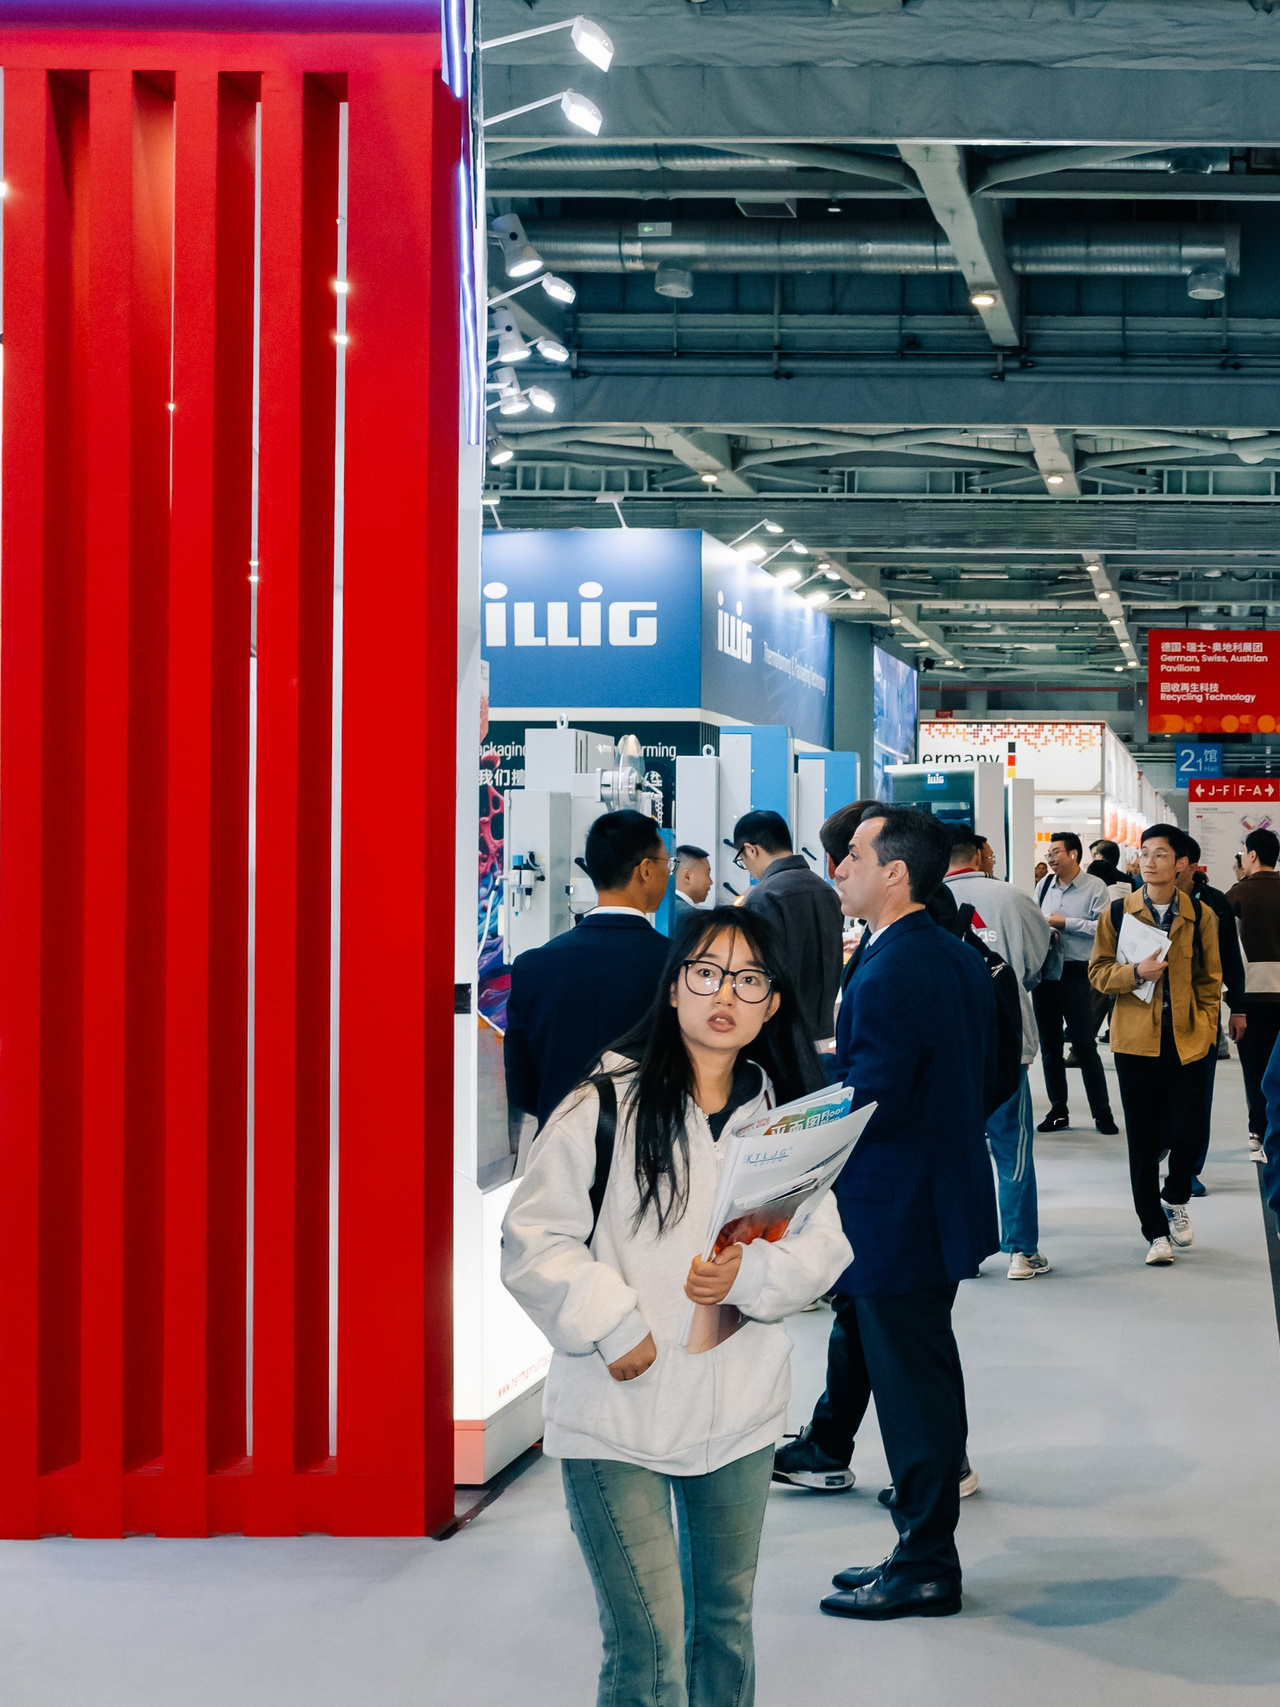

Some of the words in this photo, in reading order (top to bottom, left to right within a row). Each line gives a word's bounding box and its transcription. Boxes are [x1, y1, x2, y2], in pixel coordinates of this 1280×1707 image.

[1160, 654, 1200, 663] German,
[1201, 654, 1229, 663] Swiss,
[1230, 654, 1268, 662] Austrian
[1160, 664, 1201, 672] Pavilions
[1160, 682, 1219, 693] 回收再生科技
[1160, 693, 1203, 703] Recycling
[1205, 693, 1256, 703] Technology
[1203, 749, 1218, 763] 馆
[1208, 785, 1230, 796] J-F
[1238, 785, 1262, 796] F-A
[821, 1107, 845, 1120] Floor
